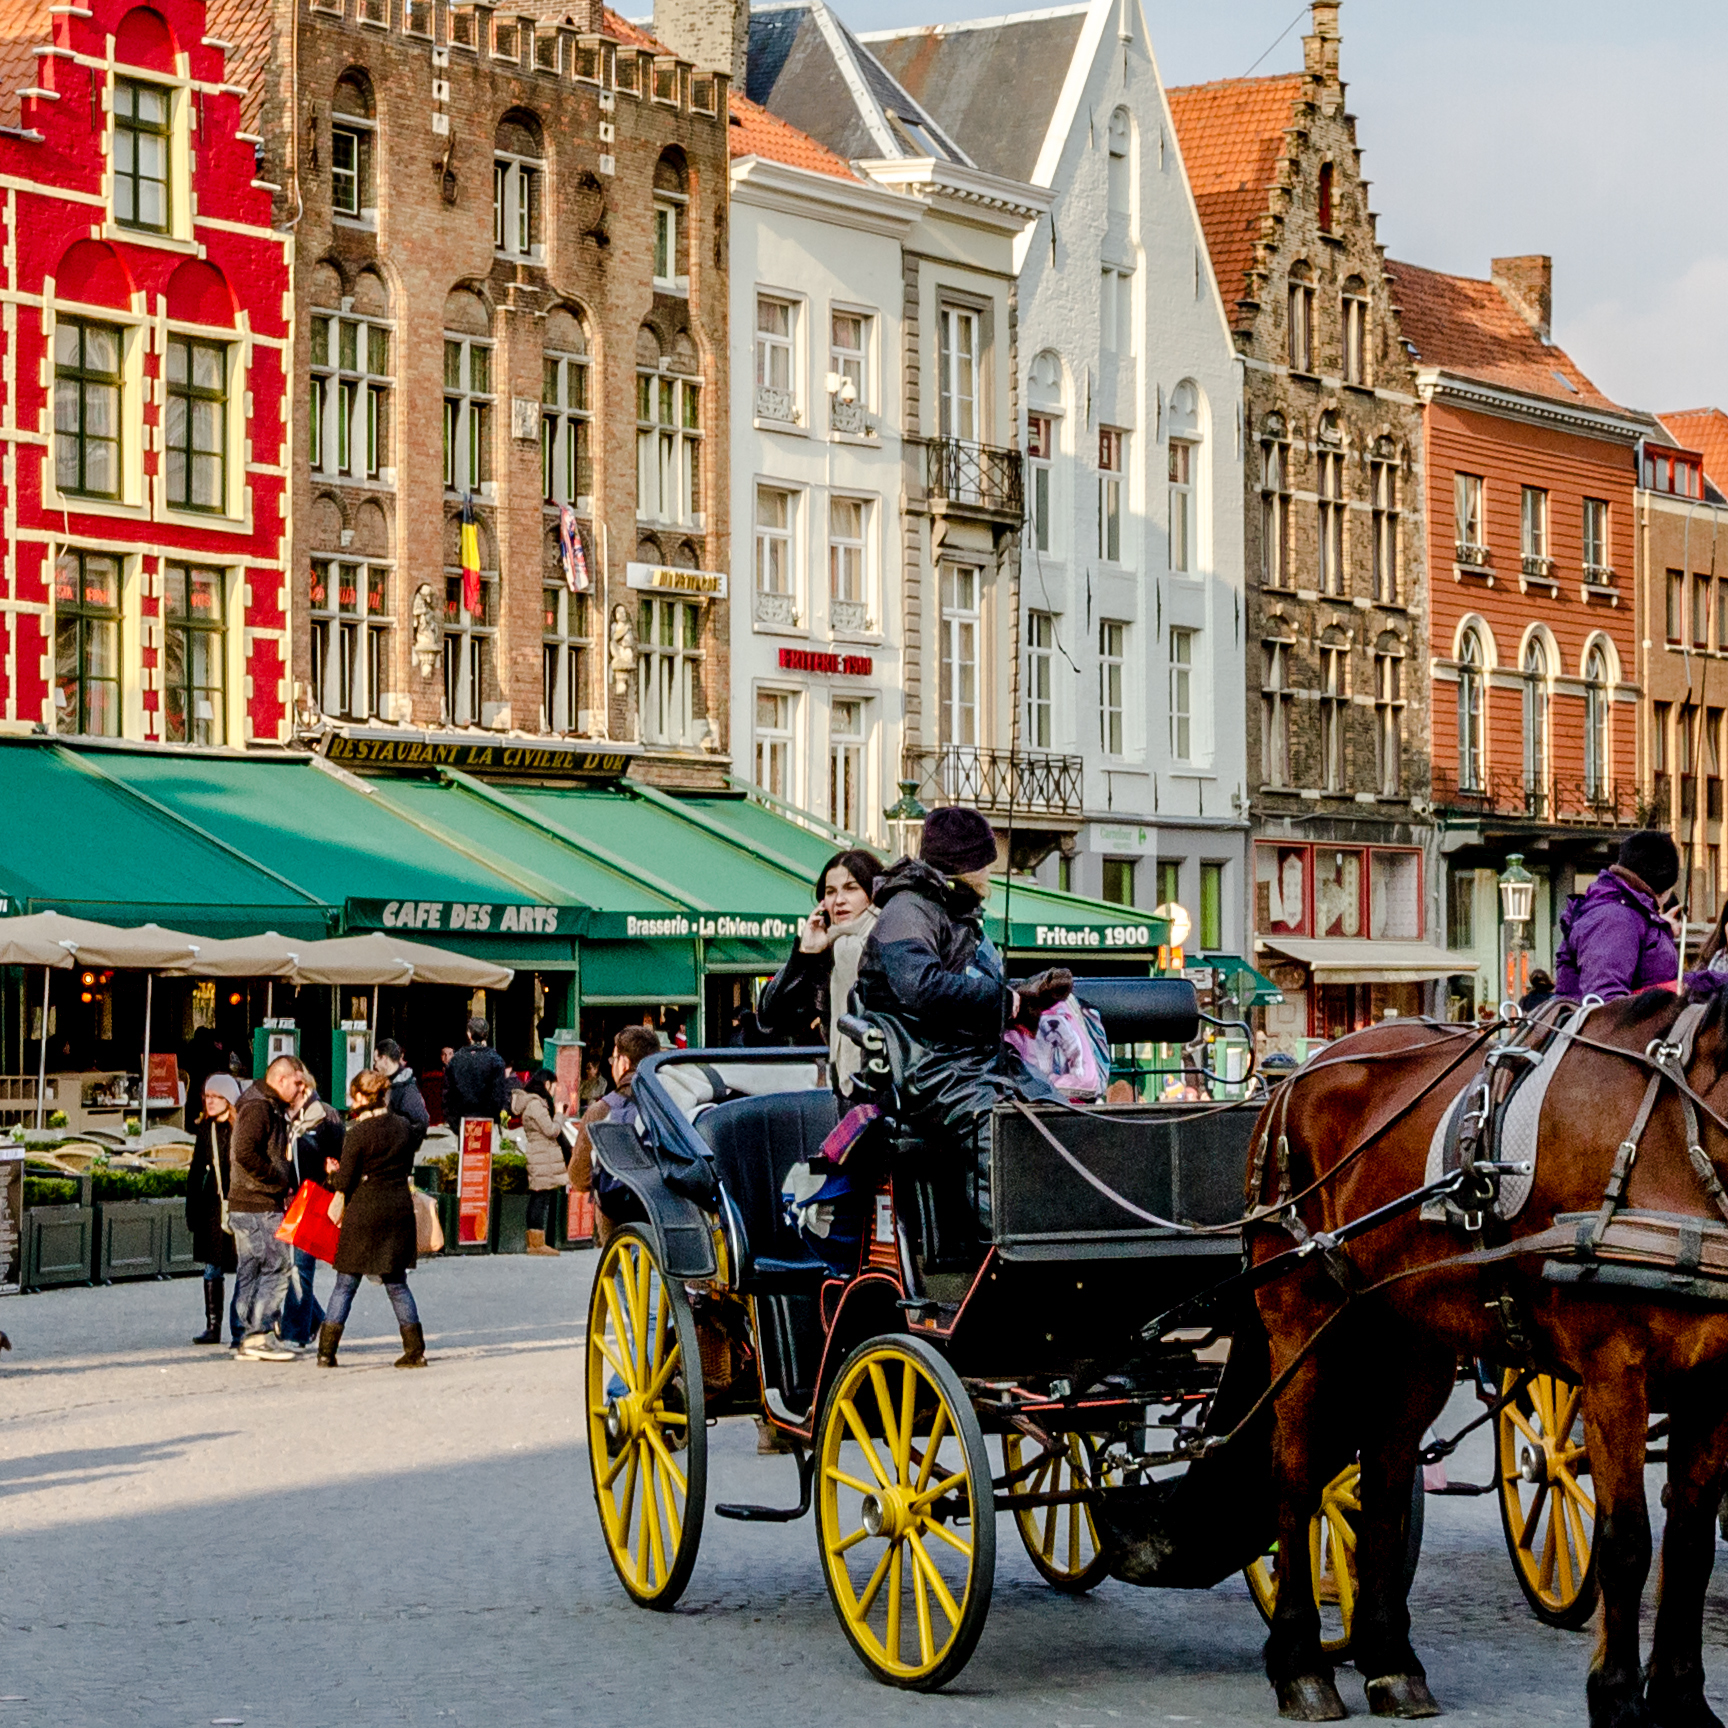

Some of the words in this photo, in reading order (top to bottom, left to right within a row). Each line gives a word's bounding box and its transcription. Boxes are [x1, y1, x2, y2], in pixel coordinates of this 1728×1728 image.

[329, 738, 461, 763] RESTAURANT
[467, 746, 493, 765] LA
[583, 752, 624, 771] D'OR
[382, 901, 442, 929] CAFE
[449, 903, 492, 931] DES
[500, 906, 558, 934] ARTS
[626, 915, 689, 937] Brasserie
[699, 916, 715, 937] La
[716, 916, 760, 938] Civiere
[761, 917, 788, 938] d'Or
[1036, 926, 1100, 945] Friterie
[1104, 925, 1149, 945] 1900
